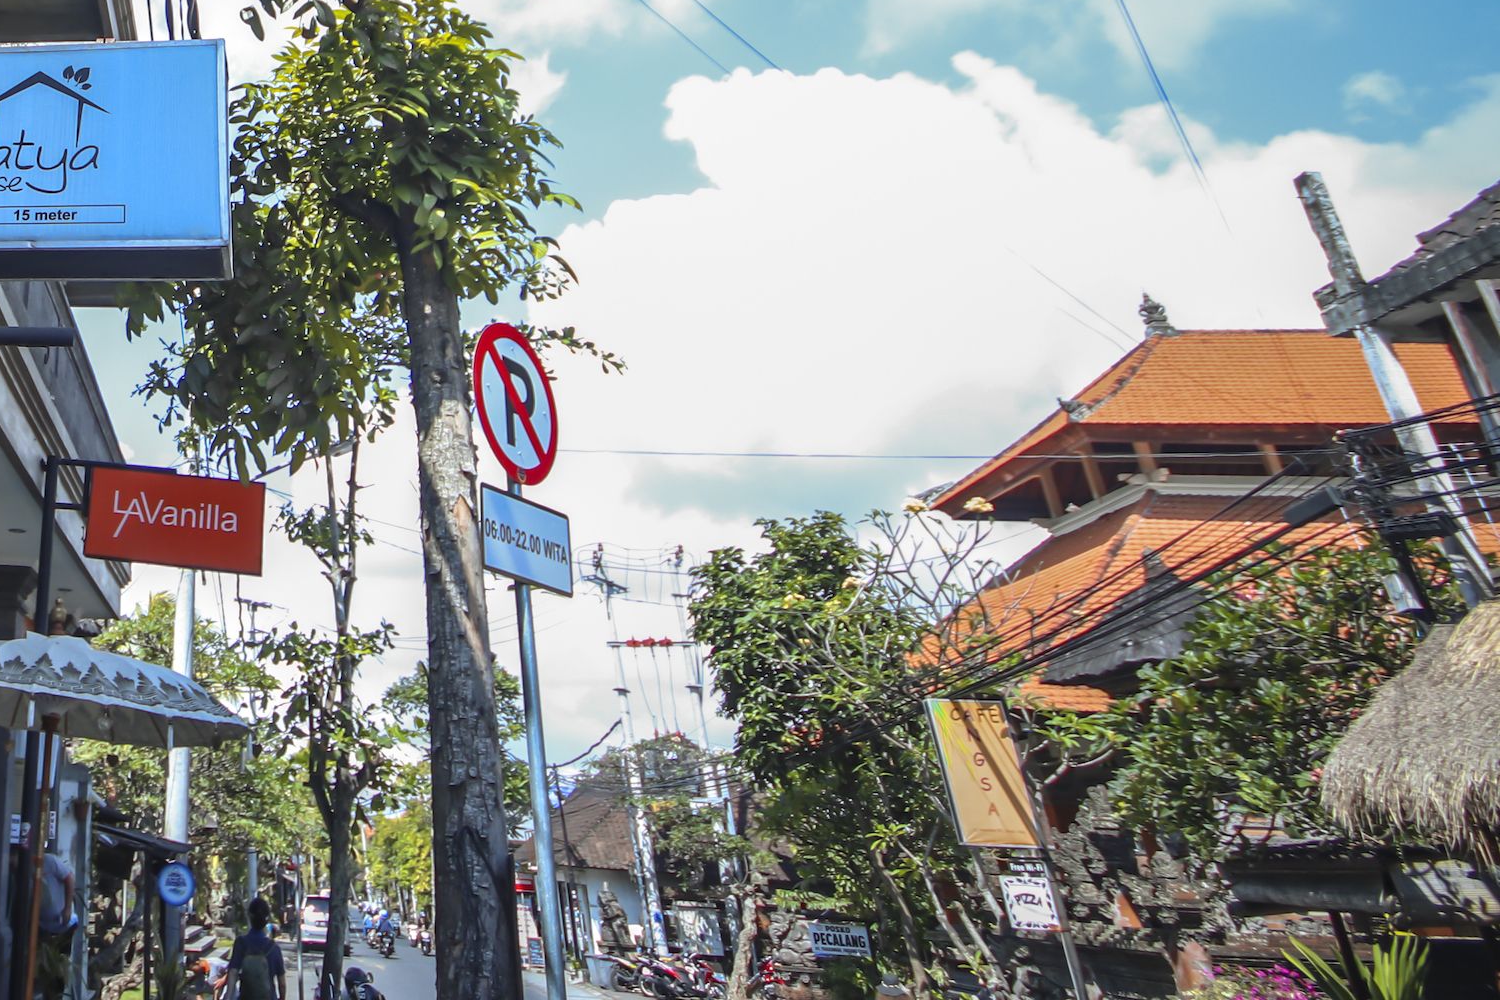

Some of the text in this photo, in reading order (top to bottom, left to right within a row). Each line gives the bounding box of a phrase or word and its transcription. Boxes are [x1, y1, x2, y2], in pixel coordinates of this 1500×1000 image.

[13, 209, 78, 221] 15 meter
[484, 518, 569, 566] 06.00-22.00 WITA
[1009, 862, 1025, 872] Free
[1013, 893, 1044, 909] PIZZA
[812, 931, 866, 948] PECALANG
